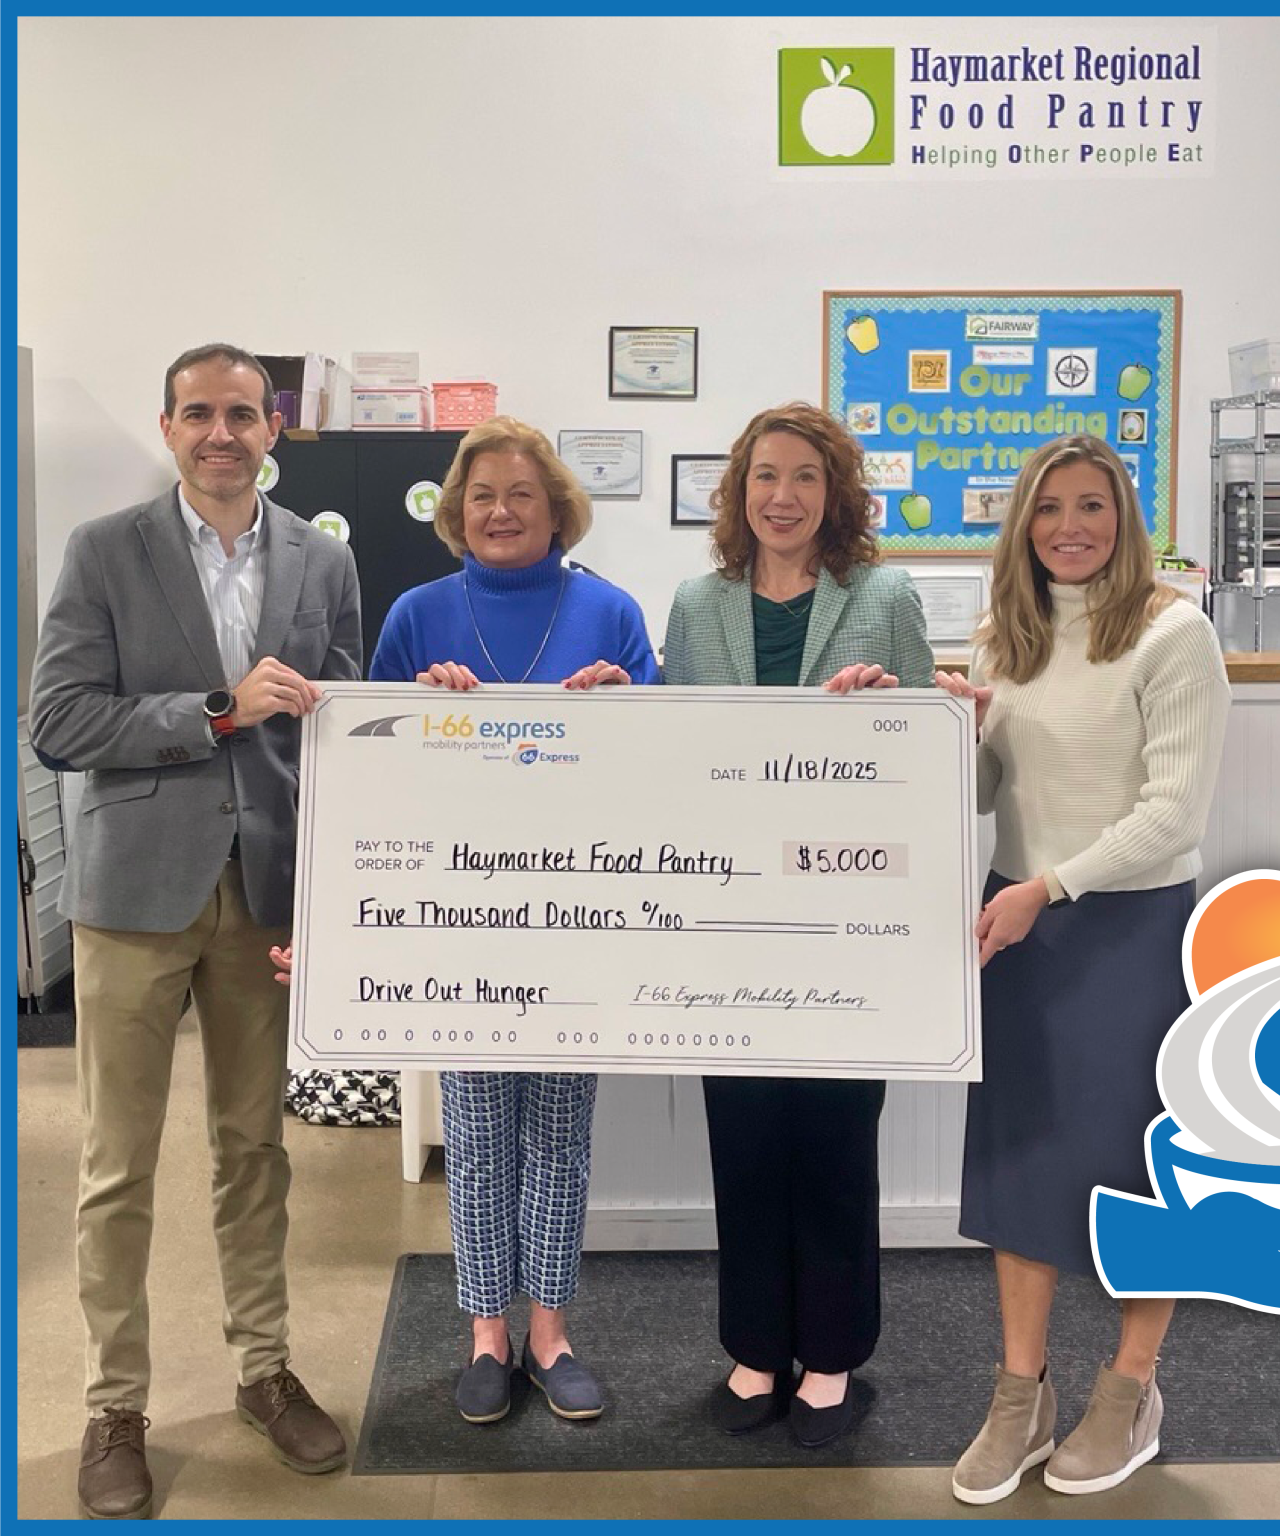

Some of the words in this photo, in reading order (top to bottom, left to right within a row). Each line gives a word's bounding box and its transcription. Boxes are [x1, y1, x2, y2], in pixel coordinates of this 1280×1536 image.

[910, 46, 1065, 87] Haymarket
[1074, 46, 1201, 86] Regional
[910, 94, 1015, 130] Food
[1047, 93, 1203, 133] Pantry
[911, 145, 997, 168] Helping
[1008, 144, 1069, 164] Other
[1080, 144, 1158, 167] People
[1168, 143, 1203, 163] Eat
[988, 321, 1034, 332] FAIRWAY
[959, 364, 1031, 398] Our
[886, 402, 1107, 439] Outstanding
[422, 713, 474, 738] I-66
[479, 721, 566, 744] express
[873, 719, 908, 732] 0001
[423, 740, 463, 751] mobility
[464, 741, 506, 751] partners
[540, 752, 580, 763] Express
[711, 769, 747, 781] DATE
[764, 753, 878, 783] 11/18/2025
[355, 840, 380, 853] PAY
[384, 841, 403, 853] TO
[407, 841, 434, 853] THE
[354, 858, 402, 870] ORDER
[405, 859, 425, 870] OF
[451, 842, 576, 880] Haymarket
[590, 841, 643, 874] Food
[658, 843, 734, 886] Pantry
[359, 896, 406, 927] Five
[415, 900, 530, 928] Thousand
[545, 901, 626, 930] Dollars
[846, 923, 911, 936] DOLLARS
[358, 976, 414, 1002] Drive
[424, 977, 463, 1002] Out
[476, 977, 549, 1017] Hunger
[632, 984, 671, 1002] I-66
[675, 985, 728, 1009] Express
[733, 987, 799, 1011] Mobility
[802, 988, 868, 1009] Partners
